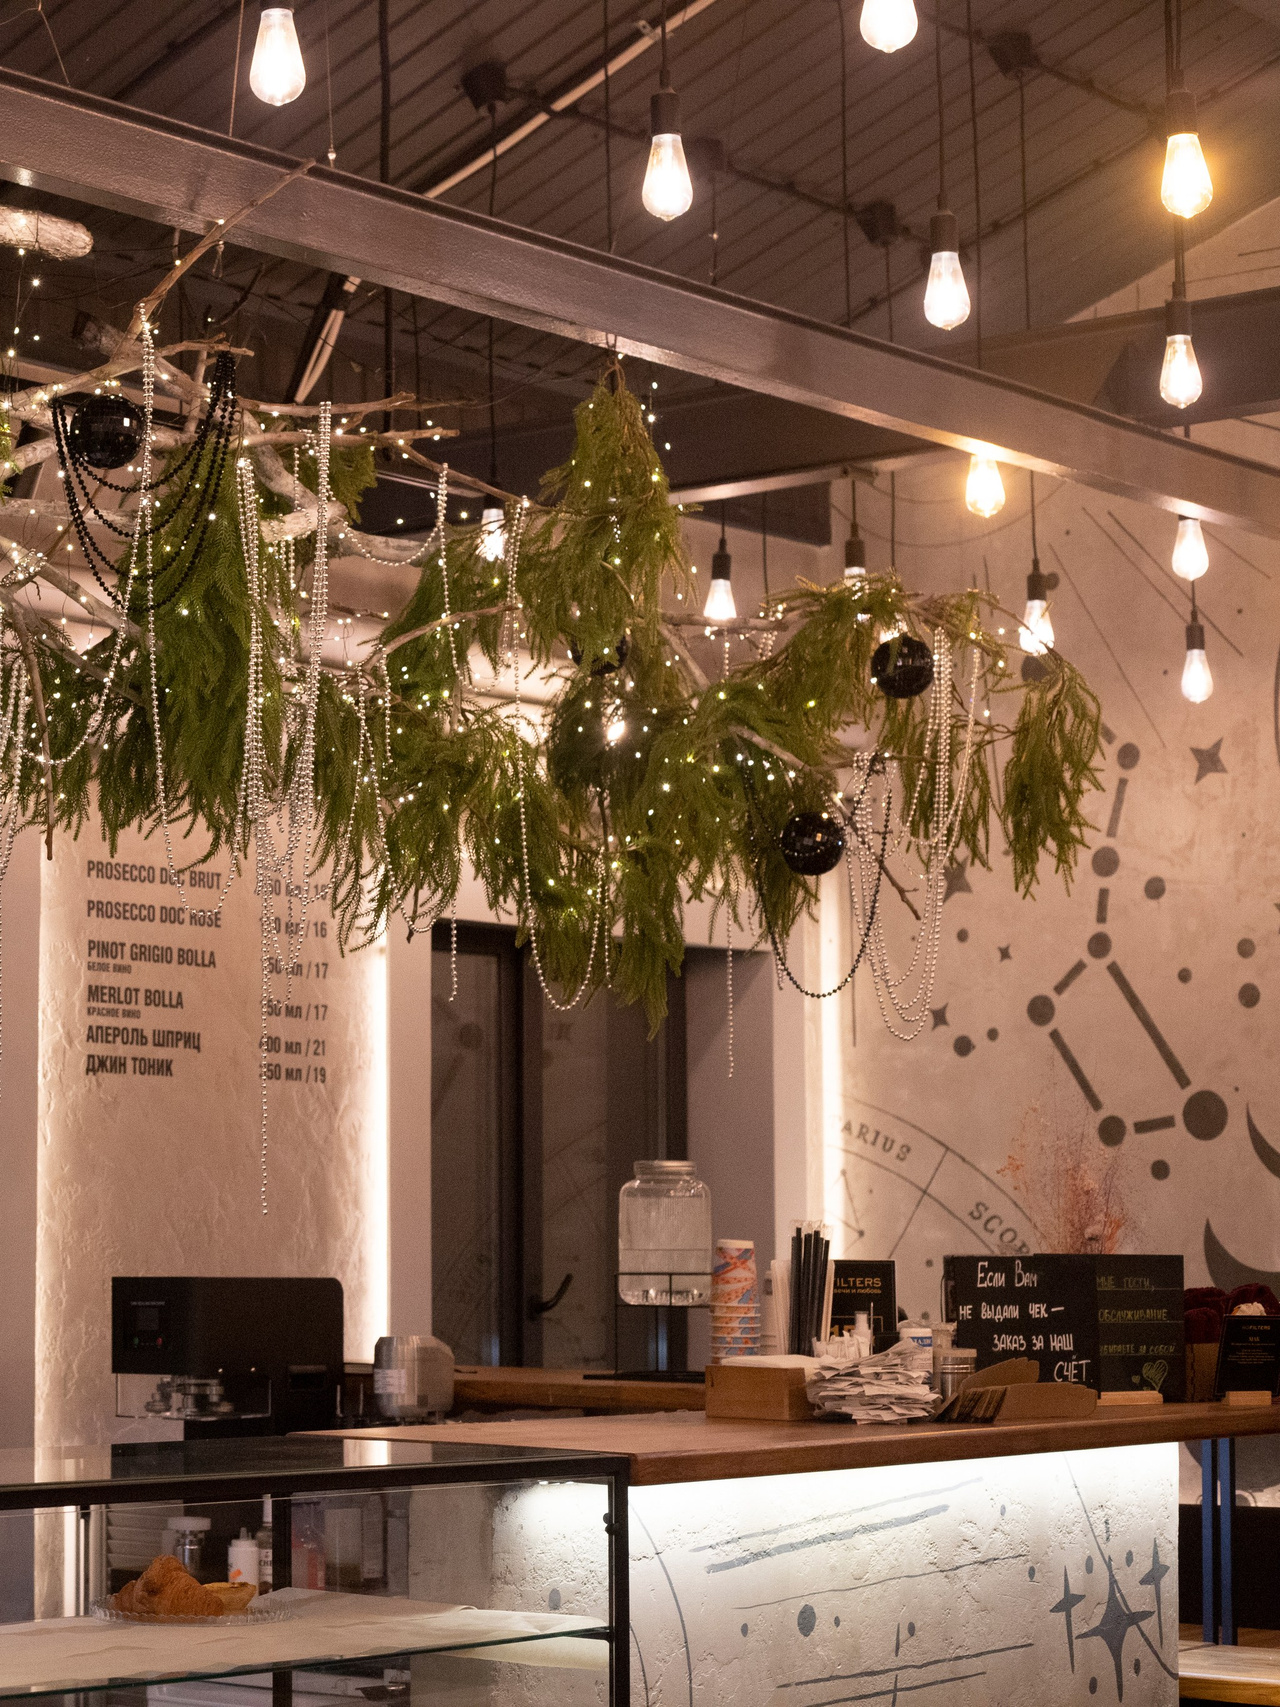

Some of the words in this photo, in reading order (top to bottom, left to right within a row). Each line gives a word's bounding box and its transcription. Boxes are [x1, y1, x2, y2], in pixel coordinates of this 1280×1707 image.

[87, 860, 156, 884] PROSECCO
[159, 867, 185, 887] DOC
[189, 870, 222, 890] BRUT
[87, 899, 156, 923] PROSECCO
[160, 905, 185, 926] DOC
[313, 921, 327, 938] 16
[88, 940, 126, 960] PINOT
[129, 943, 173, 964] GRIGIO
[177, 947, 216, 969] BOLLA
[87, 961, 111, 973] БЕЛОЕ
[112, 963, 132, 975] ВИНО
[314, 962, 329, 979] 17
[87, 984, 140, 1006] MERLOT
[144, 988, 184, 1010] BOLLA
[87, 1006, 120, 1019] КРАСНОЕ
[121, 1008, 141, 1020] ВИНО
[285, 1004, 302, 1019] мл
[314, 1004, 328, 1021] 17
[86, 1024, 149, 1047] АПЕРОЛЬ
[152, 1029, 201, 1054] ШПРИЦ
[285, 1041, 302, 1055] мл
[313, 1040, 326, 1056] 21
[85, 1054, 127, 1076] ДЖИН
[131, 1056, 173, 1077] ТОНИК
[285, 1068, 302, 1082] мл
[314, 1067, 327, 1084] 19
[834, 1277, 882, 1287] ILTERS
